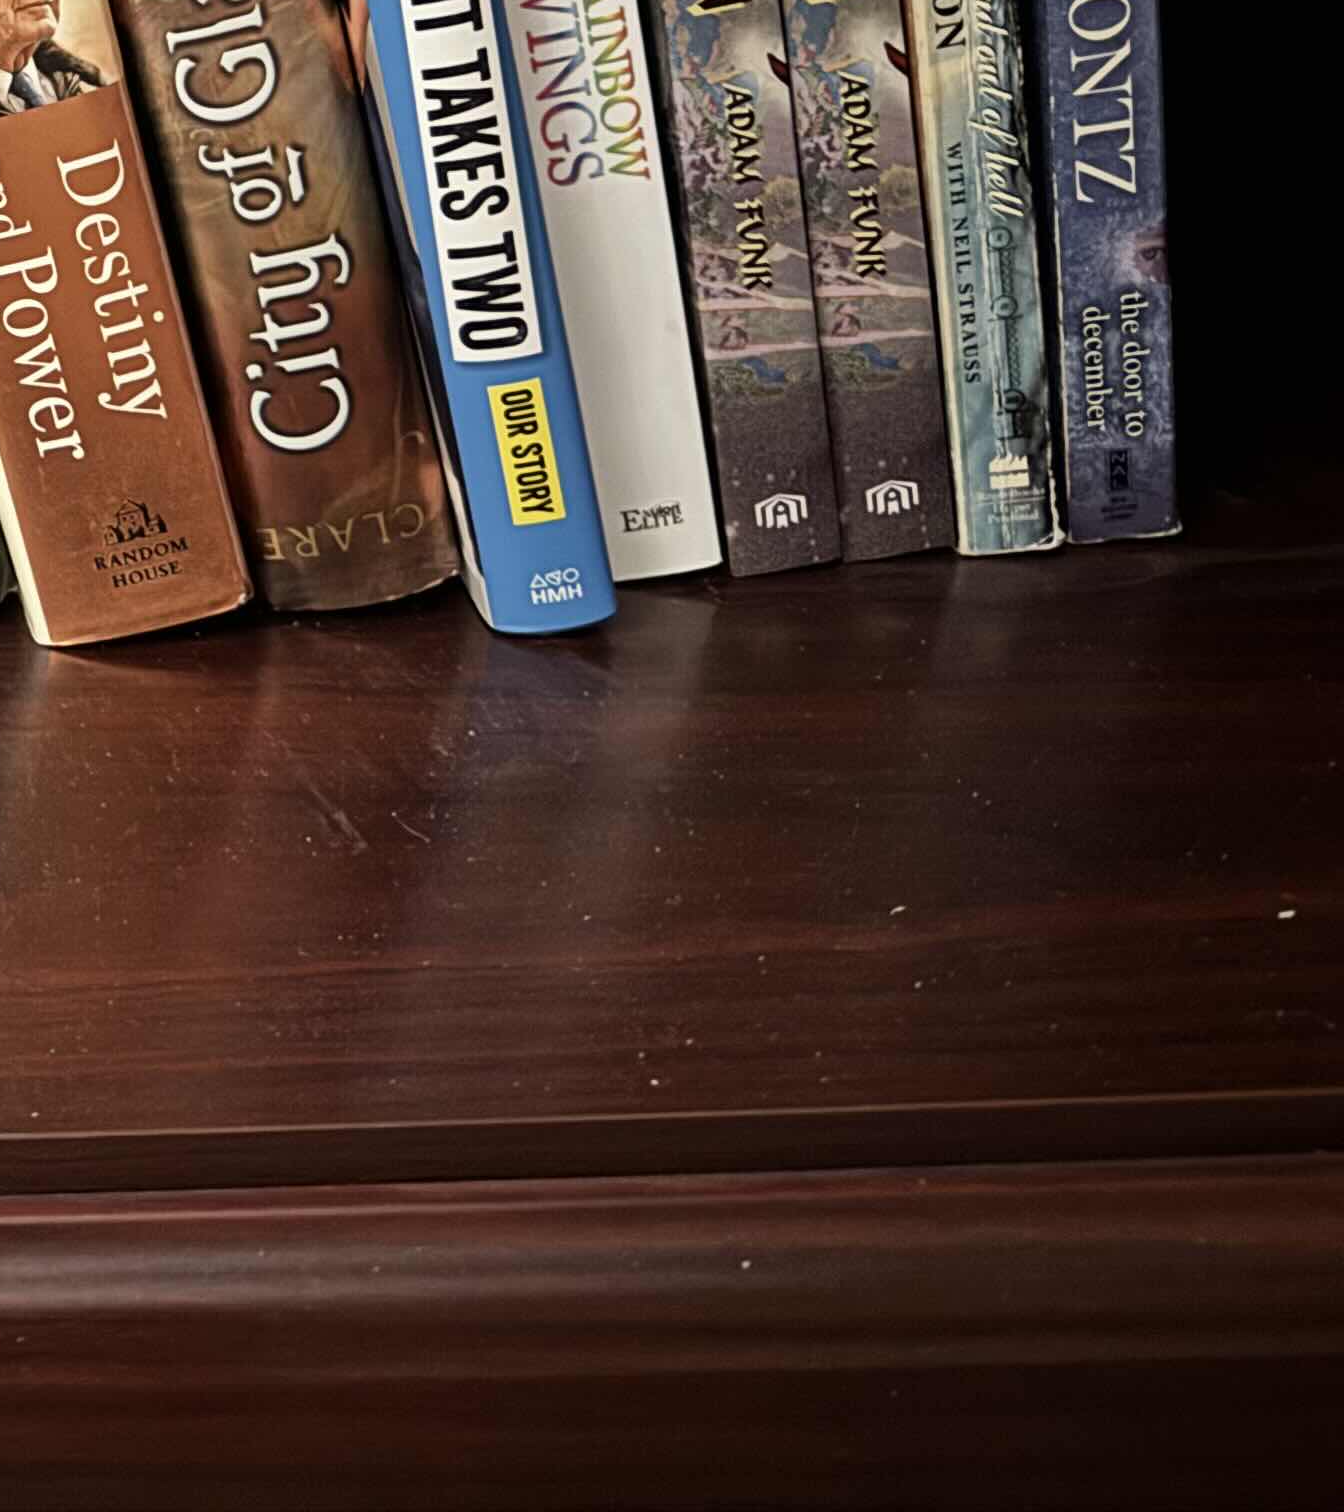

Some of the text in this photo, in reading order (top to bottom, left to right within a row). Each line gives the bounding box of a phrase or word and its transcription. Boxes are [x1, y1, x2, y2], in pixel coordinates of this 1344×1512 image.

[971, 104, 1018, 153] of
[974, 39, 1011, 107] out
[199, 144, 306, 222] of
[421, 48, 511, 224] TAKES
[722, 82, 776, 292] ADAM FUNK
[838, 70, 889, 279] ADAM FUNK
[983, 146, 1024, 222] hell
[56, 139, 170, 421] Destiny
[447, 233, 529, 352] TWO
[945, 141, 982, 384] WITH NEIL STRAUSS
[247, 232, 351, 453] City
[1081, 303, 1112, 433] december
[1119, 289, 1152, 439] the door to
[498, 387, 555, 519] OUR STORY
[94, 536, 189, 571] RANDOM
[112, 560, 184, 588] HOUSE
[261, 503, 426, 564] CLARE
[530, 582, 583, 605] HMH
